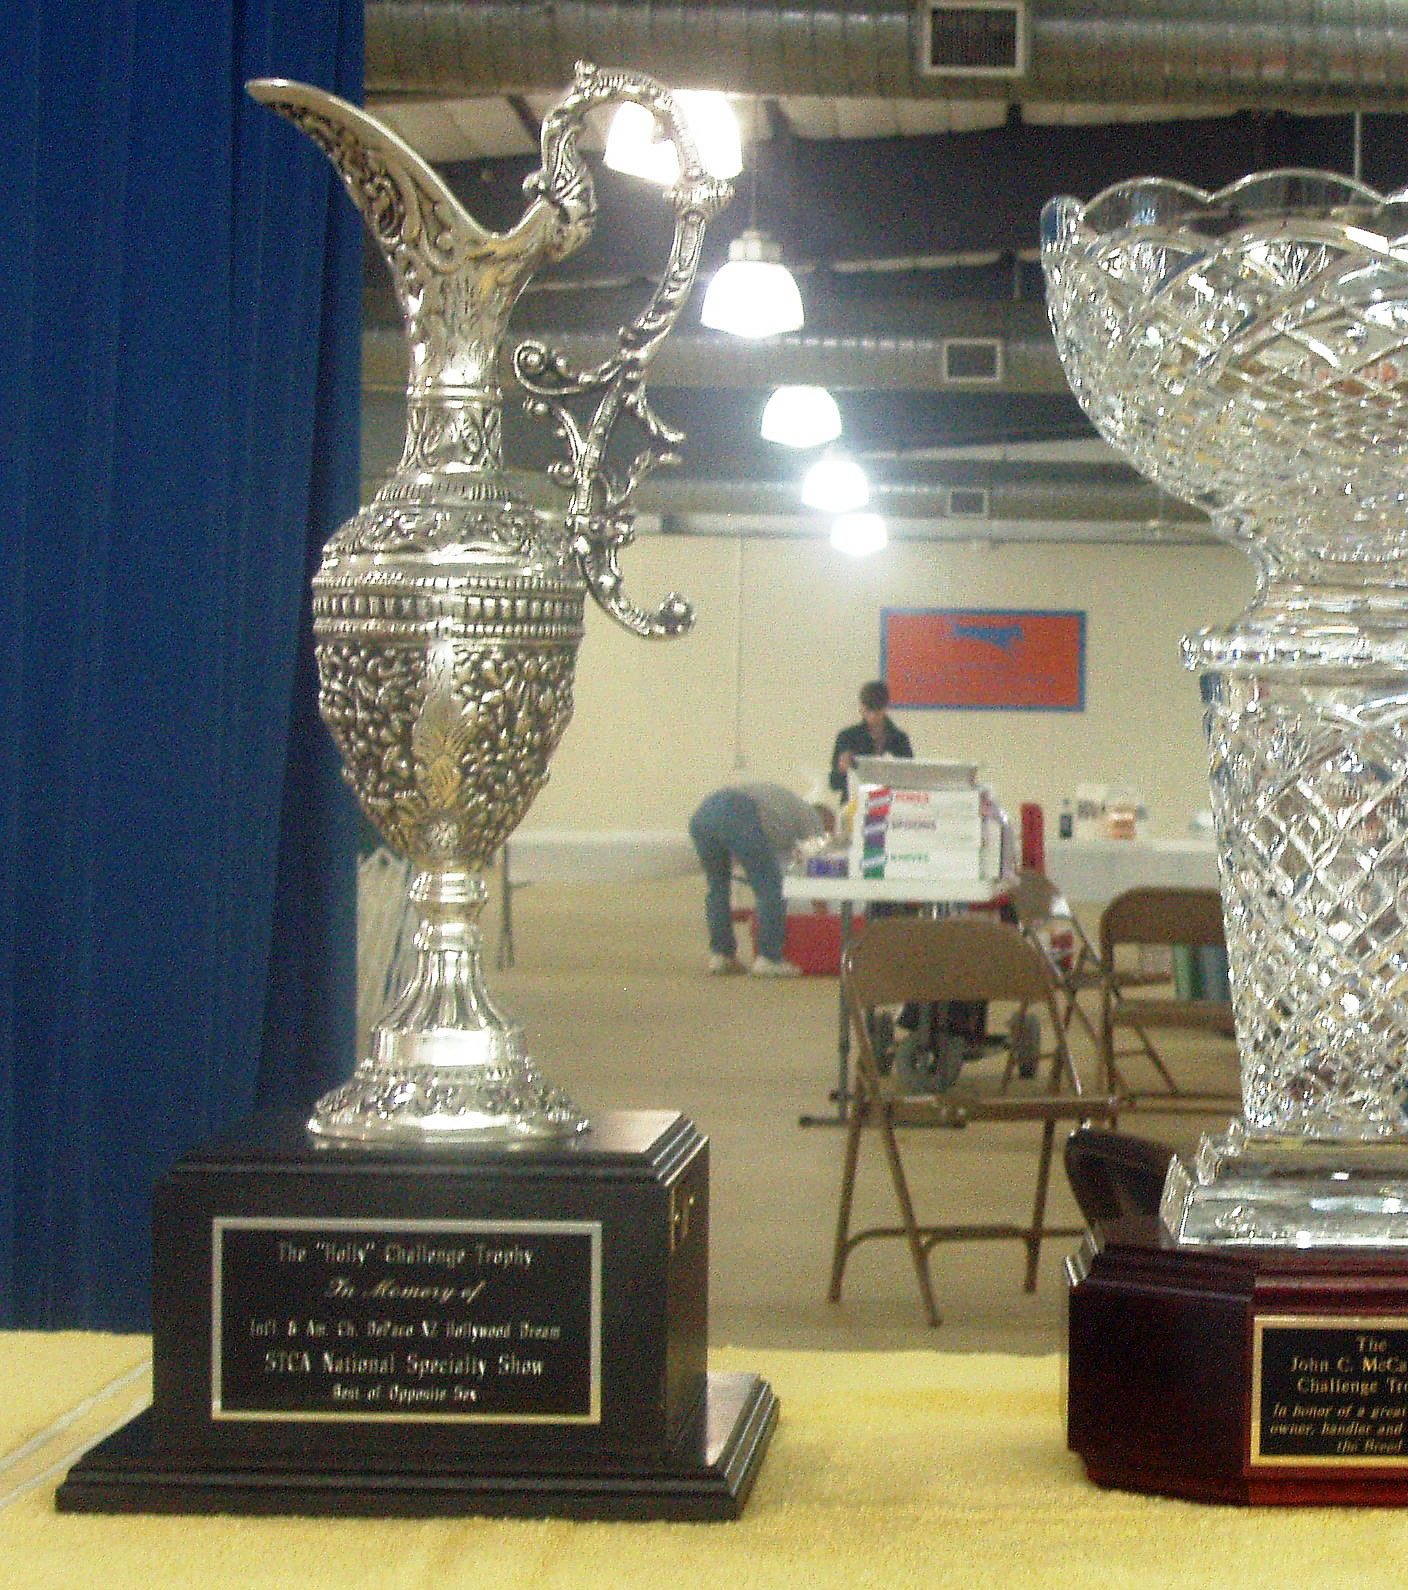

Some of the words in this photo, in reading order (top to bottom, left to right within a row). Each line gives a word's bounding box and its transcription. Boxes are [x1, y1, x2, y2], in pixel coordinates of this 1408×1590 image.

[279, 1241, 306, 1262] The
[385, 1242, 465, 1268] Challenge
[476, 1243, 532, 1268] Trophy
[327, 1277, 355, 1297] In
[362, 1278, 456, 1303] Memory
[461, 1280, 487, 1304] of
[447, 1321, 511, 1343] Hollywood
[520, 1321, 562, 1340] Dream
[1356, 1336, 1387, 1352] The
[264, 1351, 311, 1373] STCA
[323, 1351, 395, 1374] National
[407, 1352, 487, 1380] Specialty
[498, 1352, 544, 1376] Show
[1290, 1355, 1329, 1374] John
[1337, 1356, 1354, 1373] C.
[367, 1384, 381, 1400] of
[389, 1384, 447, 1404] Opposite
[1297, 1378, 1378, 1397] Challenge
[1273, 1402, 1288, 1418] In
[1293, 1403, 1331, 1418] honor
[1337, 1404, 1353, 1419] of
[1356, 1406, 1366, 1418] a
[1370, 1405, 1407, 1422] great
[1322, 1420, 1374, 1436] handler
[1377, 1421, 1404, 1436] and
[1336, 1438, 1360, 1454] the
[1364, 1438, 1405, 1455] Breed
